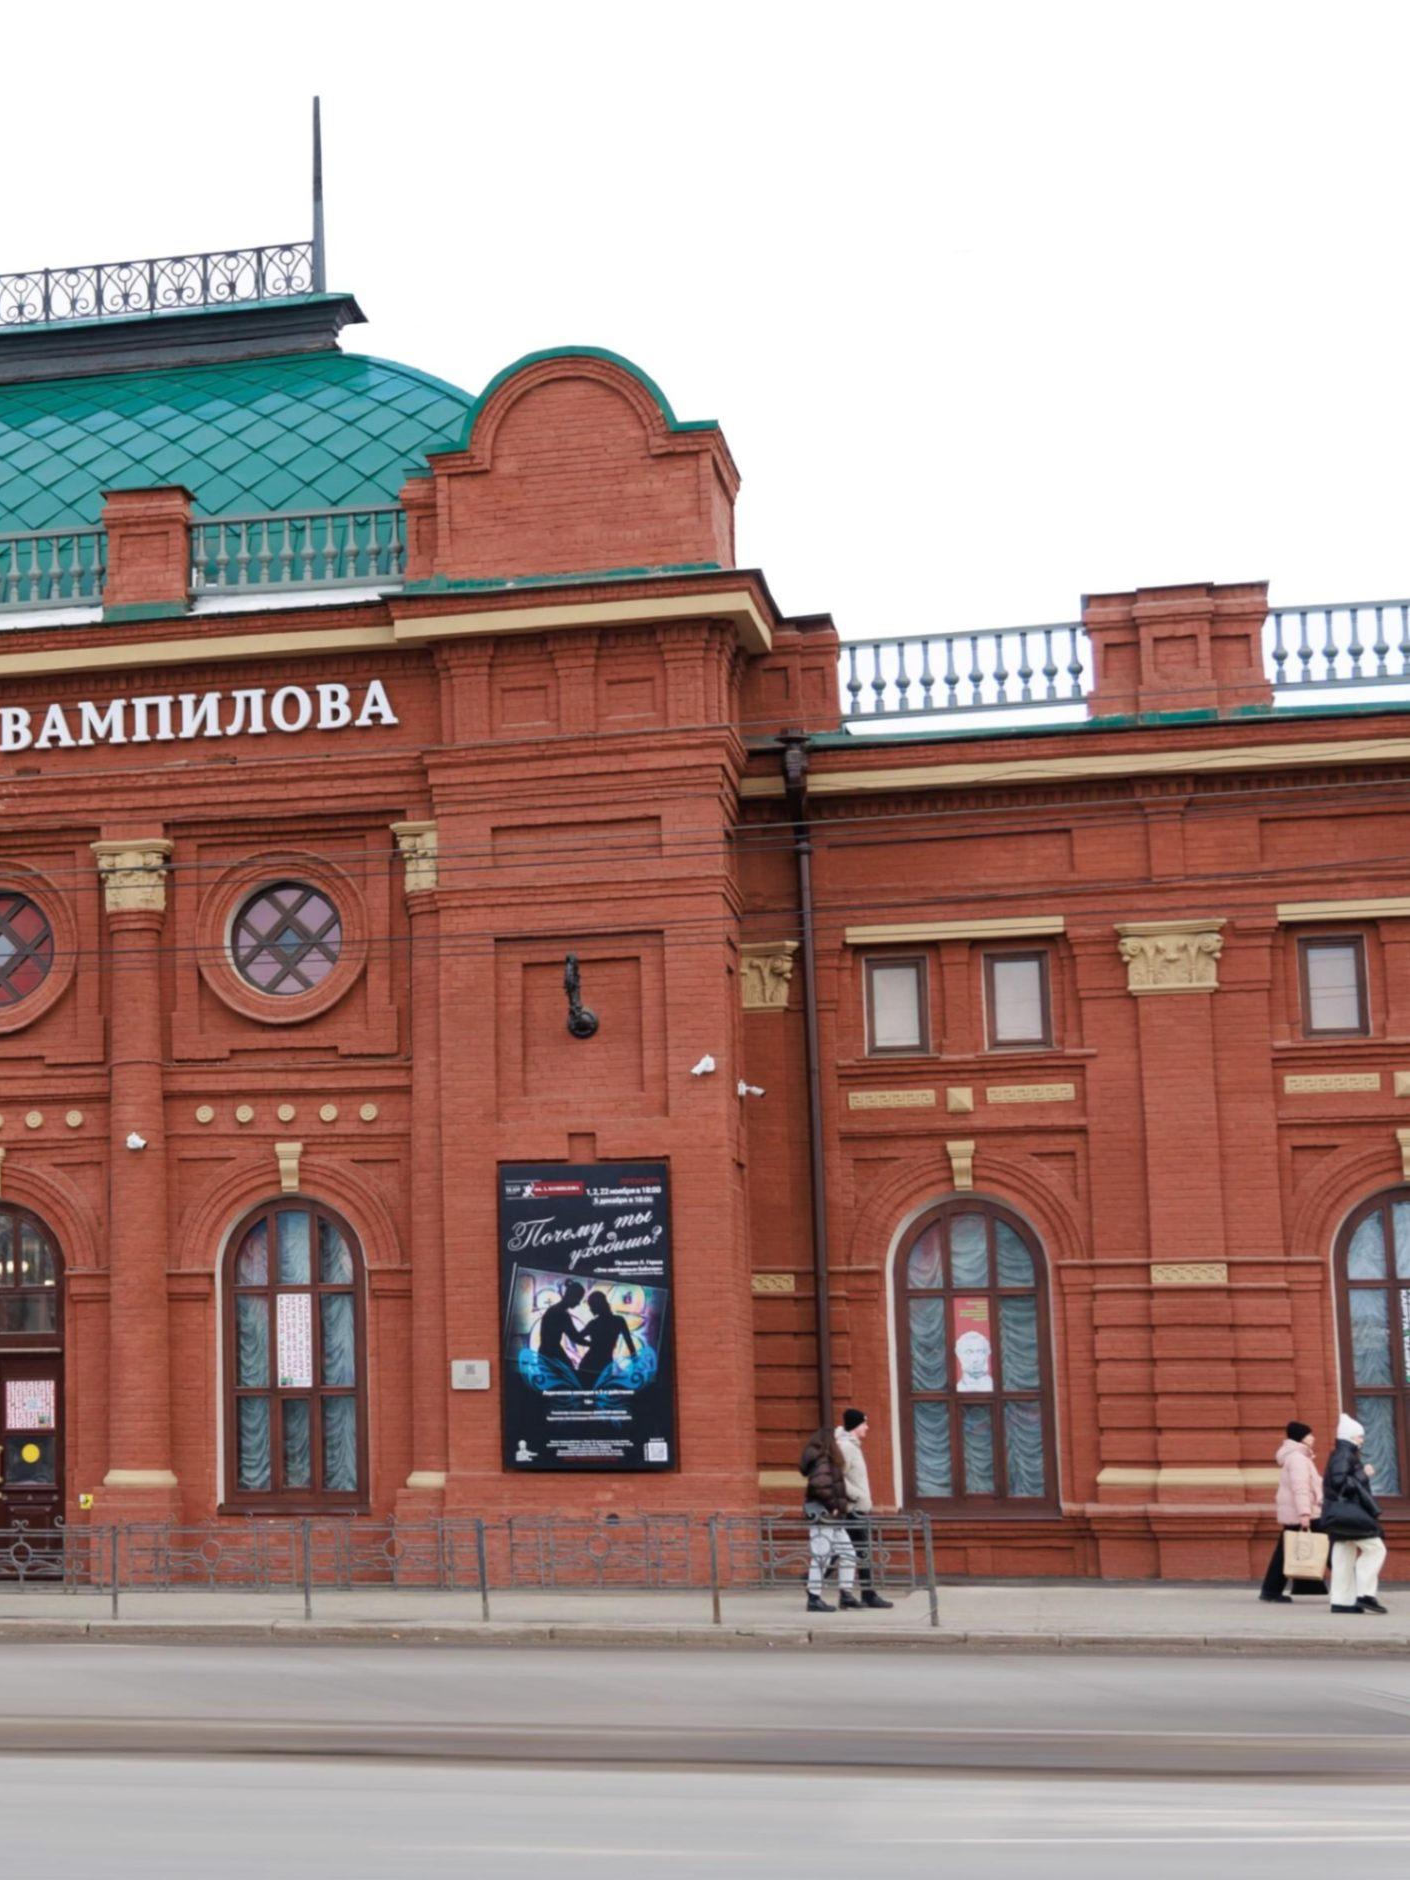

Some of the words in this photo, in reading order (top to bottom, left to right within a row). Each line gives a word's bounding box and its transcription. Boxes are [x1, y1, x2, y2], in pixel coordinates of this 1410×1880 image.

[507, 1216, 605, 1251] Почему
[614, 1210, 653, 1229] ты
[568, 1225, 663, 1271] уходишь?
